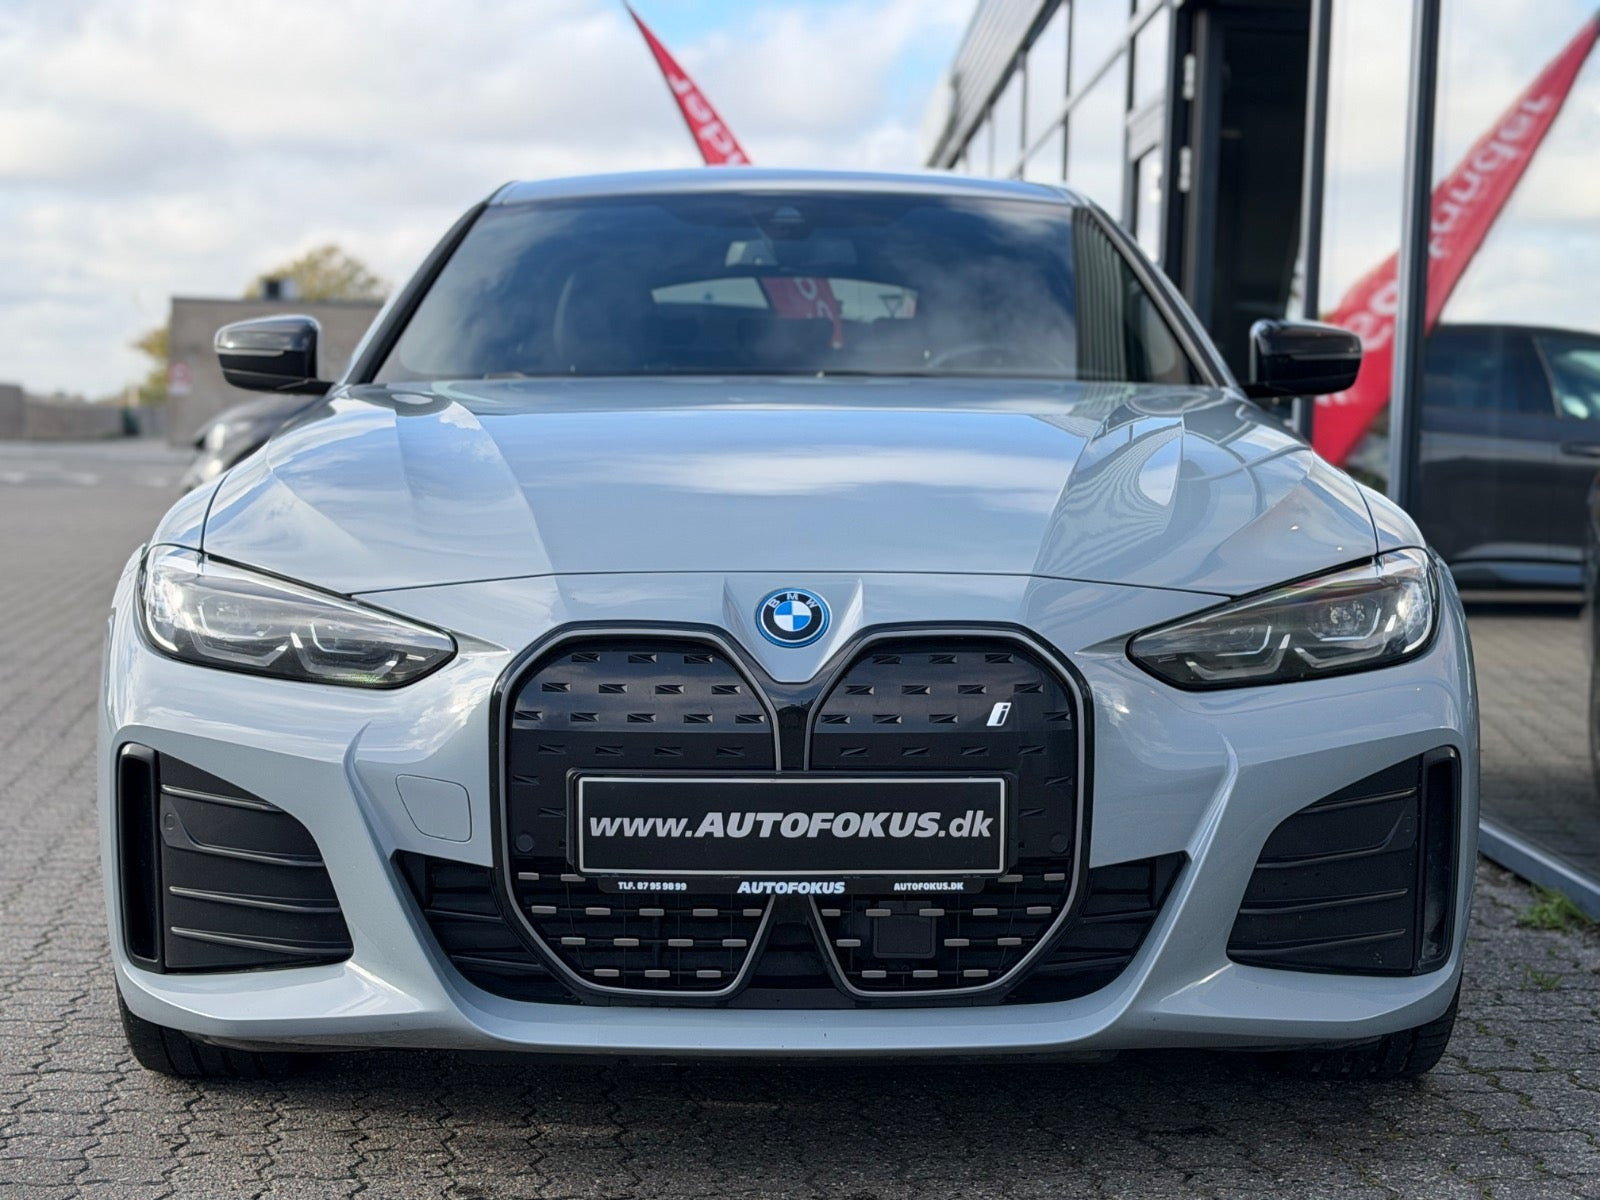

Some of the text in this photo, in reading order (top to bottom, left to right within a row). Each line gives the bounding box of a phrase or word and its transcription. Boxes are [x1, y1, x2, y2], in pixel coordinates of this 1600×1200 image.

[767, 592, 819, 609] BMW
[589, 810, 994, 838] www.AUTOFOKUS.dk
[617, 881, 636, 891] TLF.
[637, 881, 649, 891] 87
[649, 881, 662, 891] 95
[675, 881, 688, 891] 99
[736, 881, 846, 895] AUTOFOKUS
[893, 881, 965, 892] AUTOFOKUS.DK
